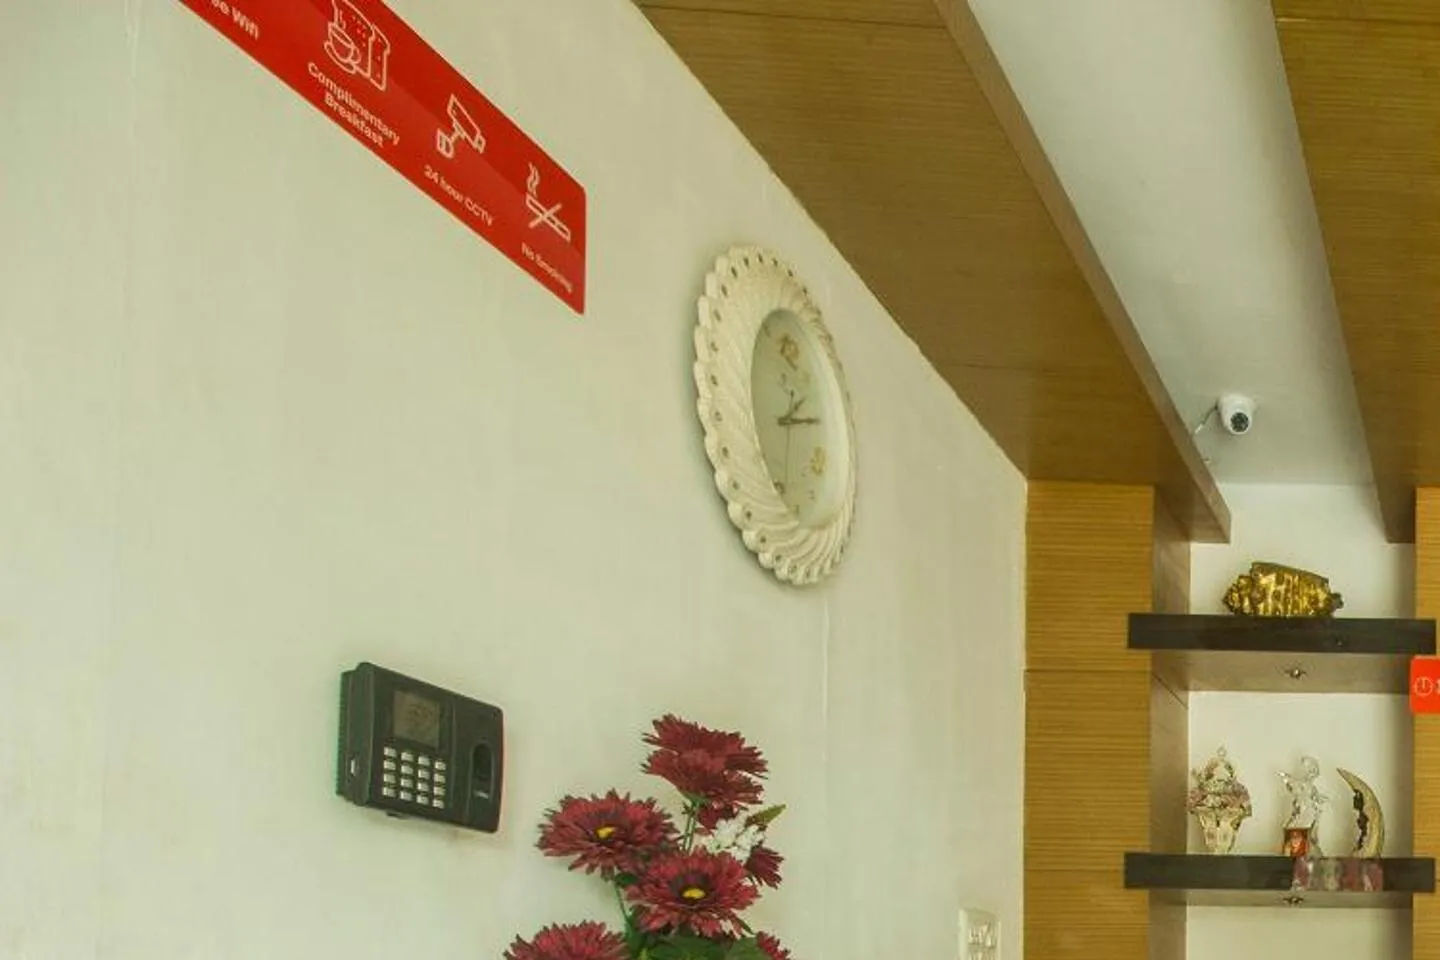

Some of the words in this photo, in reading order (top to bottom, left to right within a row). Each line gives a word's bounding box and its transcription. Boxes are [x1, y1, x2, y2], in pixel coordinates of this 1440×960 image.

[308, 62, 400, 146] Complimentary
[325, 88, 384, 148] Breakfast
[424, 164, 439, 185] 24
[464, 196, 493, 227] CCTV
